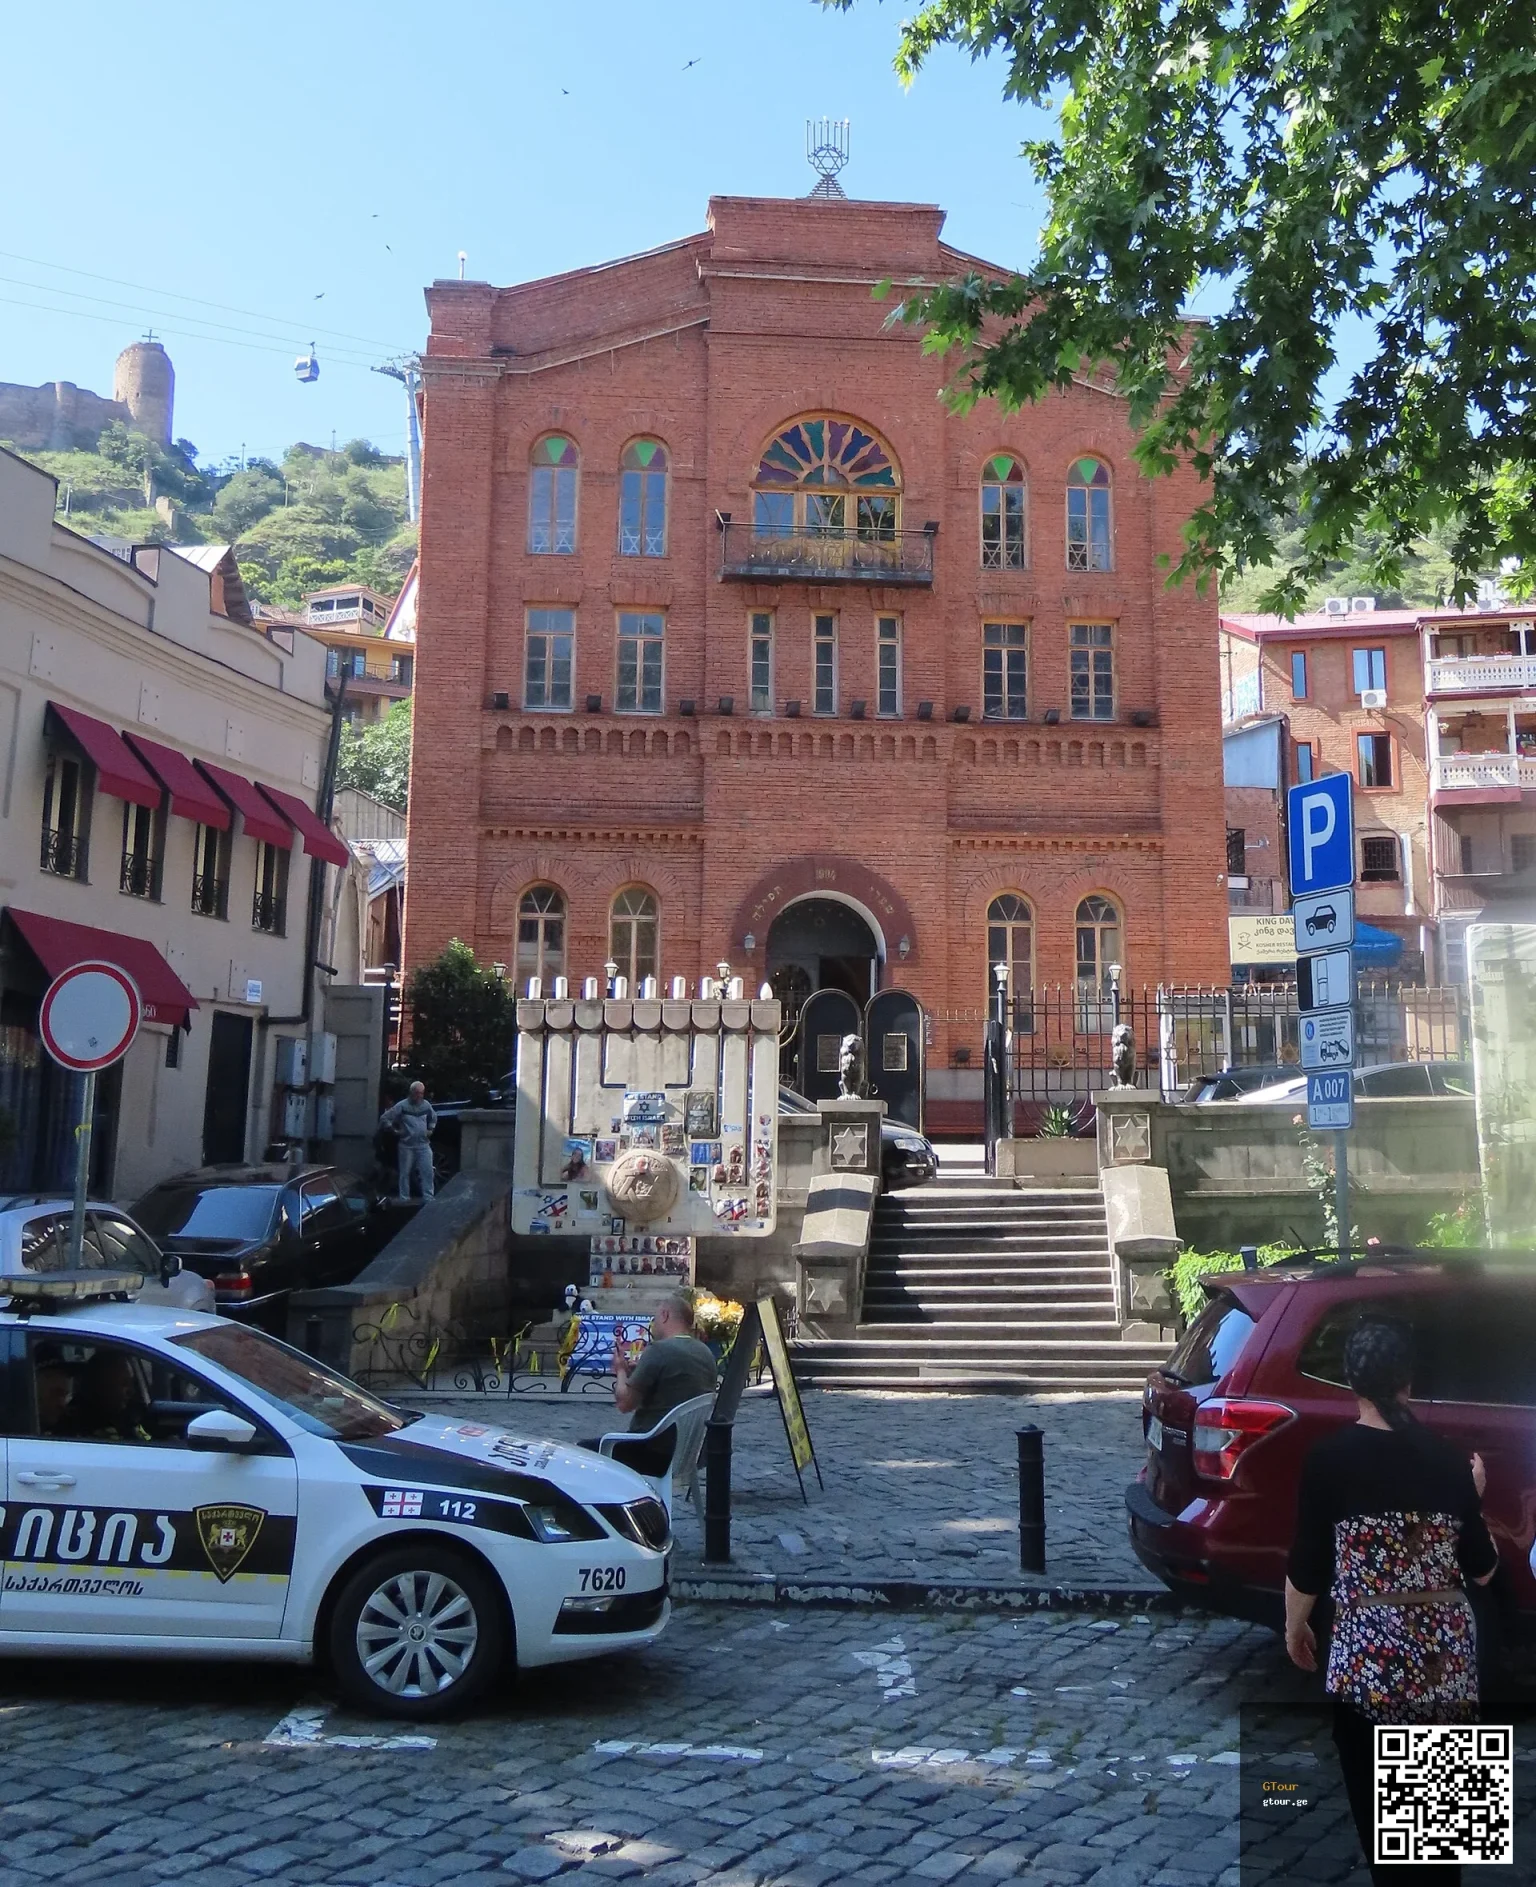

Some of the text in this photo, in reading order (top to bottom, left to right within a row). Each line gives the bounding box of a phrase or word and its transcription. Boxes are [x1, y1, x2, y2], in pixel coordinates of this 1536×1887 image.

[1302, 792, 1336, 881] P
[1254, 926, 1275, 936] კინგ
[1256, 917, 1277, 925] KING
[1312, 1077, 1345, 1101] A 007
[438, 1500, 477, 1519] 112
[4, 1576, 144, 1596] საქართველოს
[578, 1567, 626, 1591] 7620
